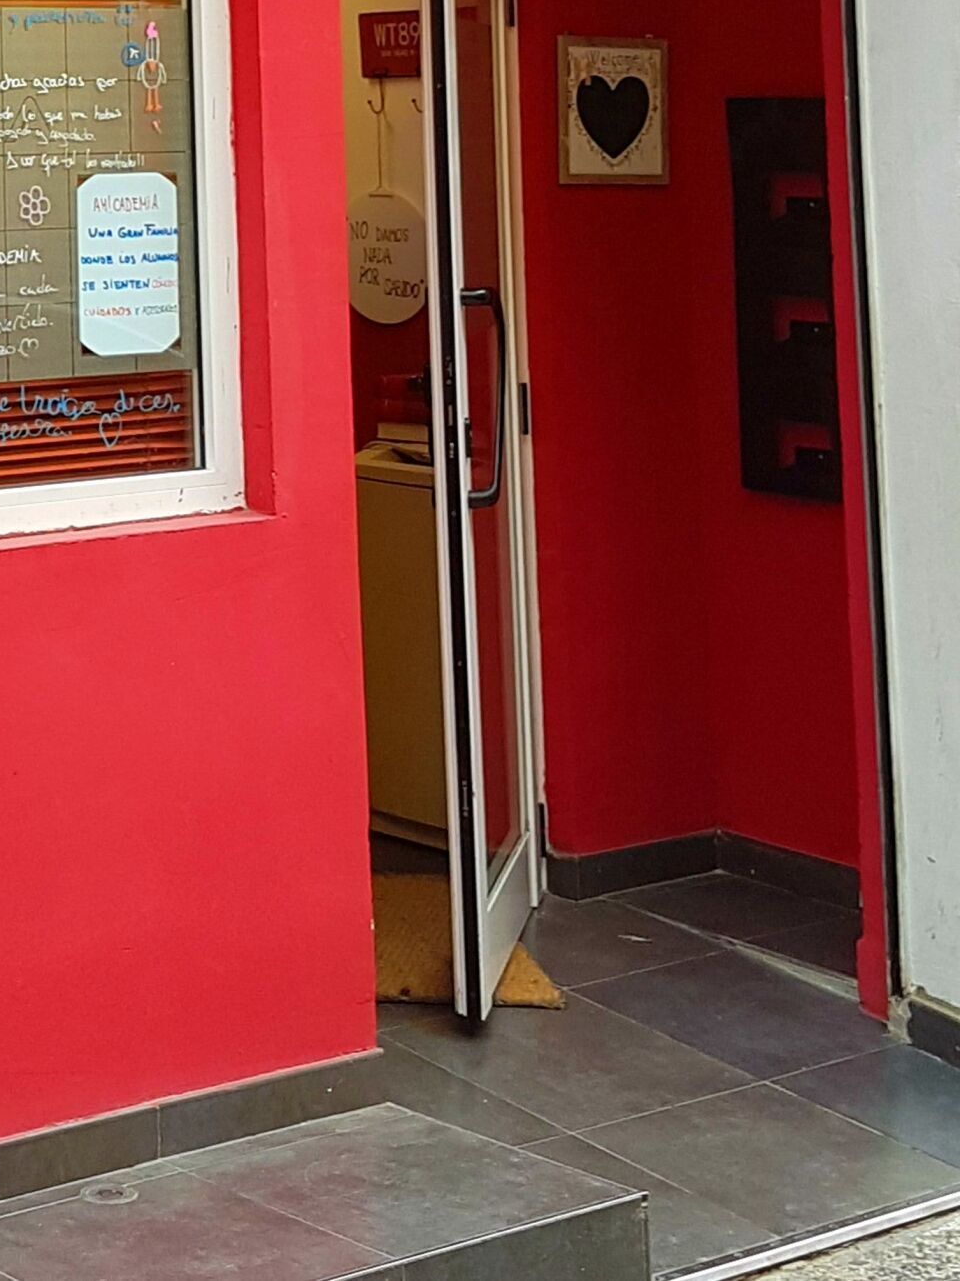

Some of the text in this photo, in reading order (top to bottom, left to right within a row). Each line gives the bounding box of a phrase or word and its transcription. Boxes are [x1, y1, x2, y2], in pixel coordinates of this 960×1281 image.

[32, 72, 85, 95] gracias
[95, 76, 119, 92] por
[88, 227, 114, 239] UNA
[81, 277, 151, 292] SE SIENTEN
